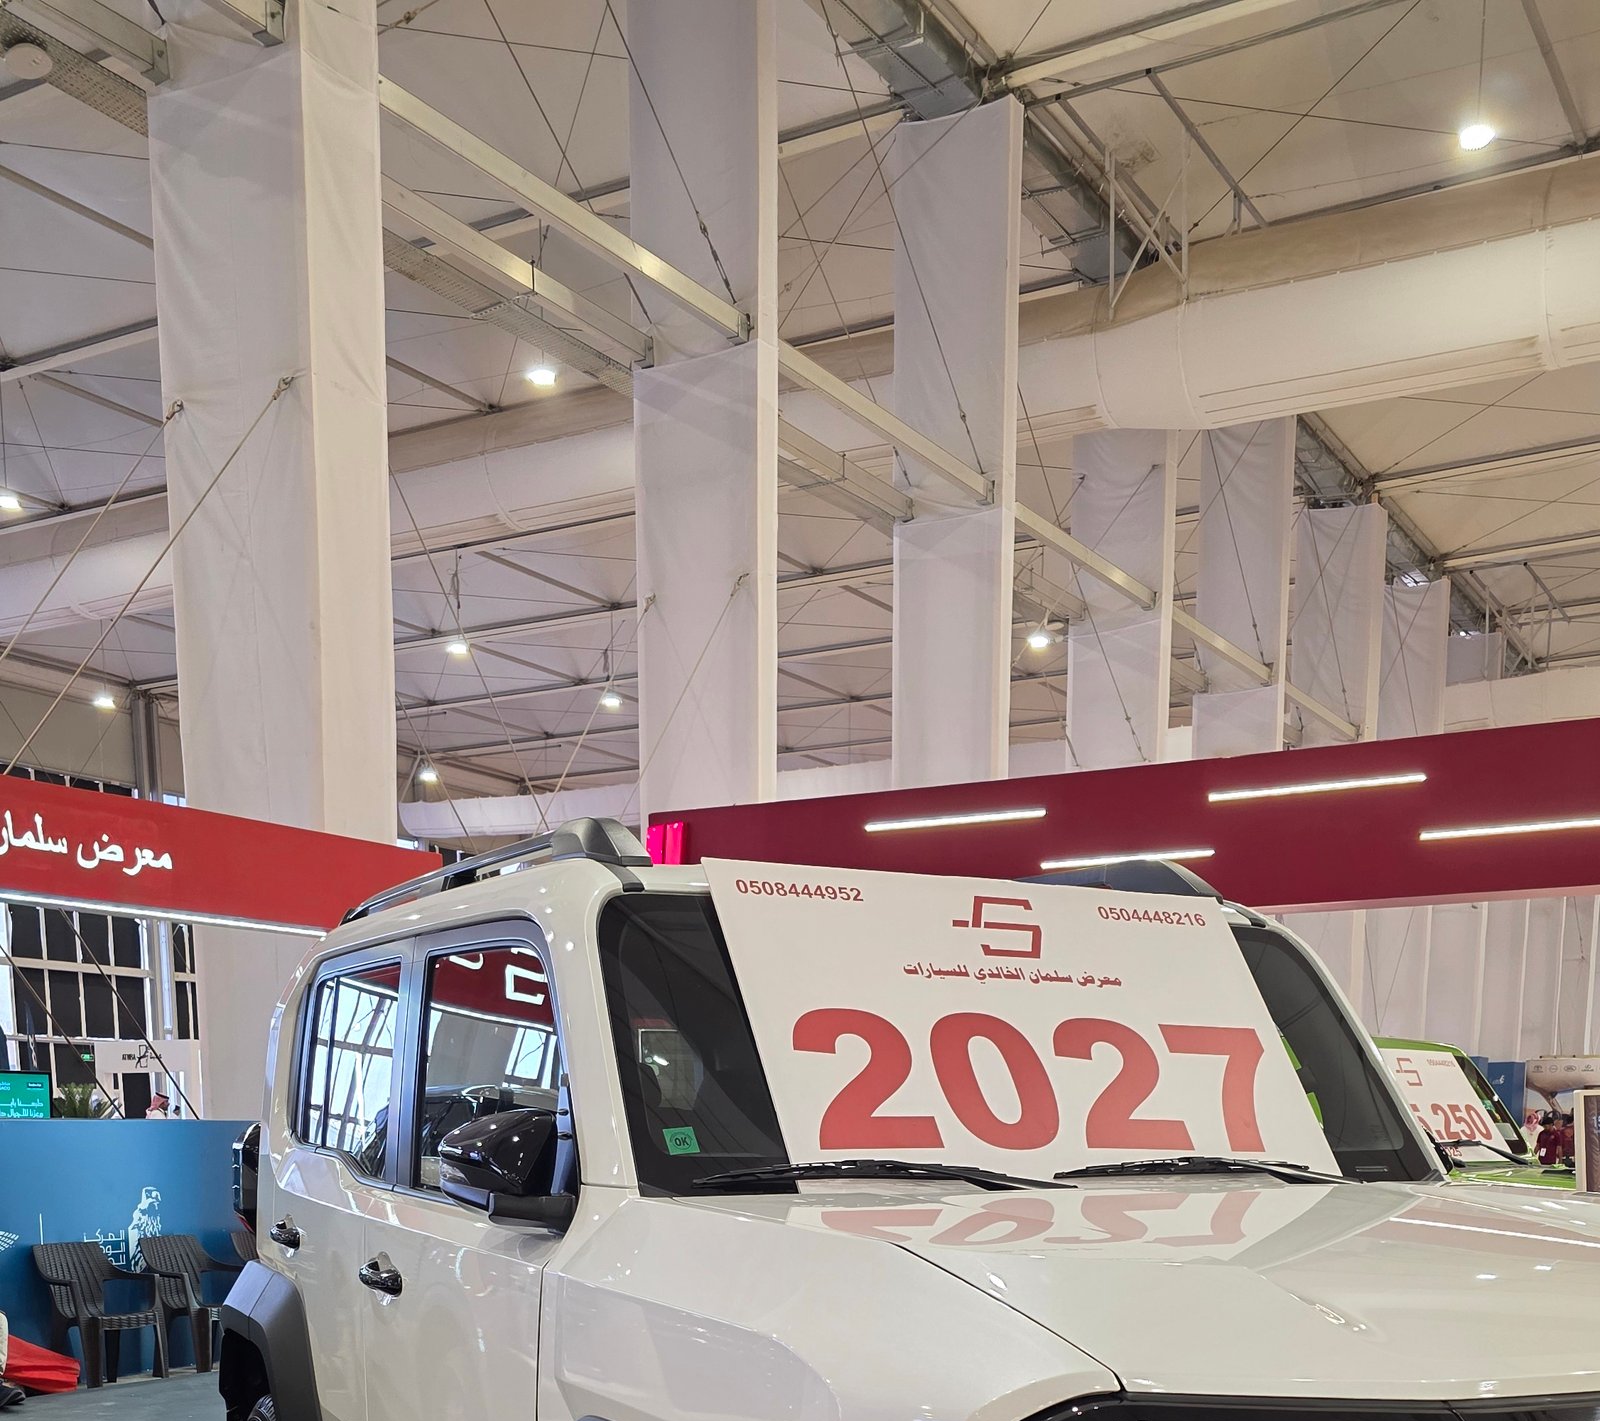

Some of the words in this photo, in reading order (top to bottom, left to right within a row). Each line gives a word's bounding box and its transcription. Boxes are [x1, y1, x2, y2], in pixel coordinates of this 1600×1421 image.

[77, 834, 173, 876] معرض
[735, 879, 864, 902] 0508444952
[1097, 906, 1206, 927] 0504448216
[903, 961, 970, 979] للسيارات
[973, 966, 1026, 984] الخالدي
[1028, 968, 1074, 984] سلمان
[1076, 971, 1122, 988] معرض
[792, 1007, 1266, 1152] 2027
[674, 1136, 690, 1147] OK
[83, 1228, 125, 1245] المركز
